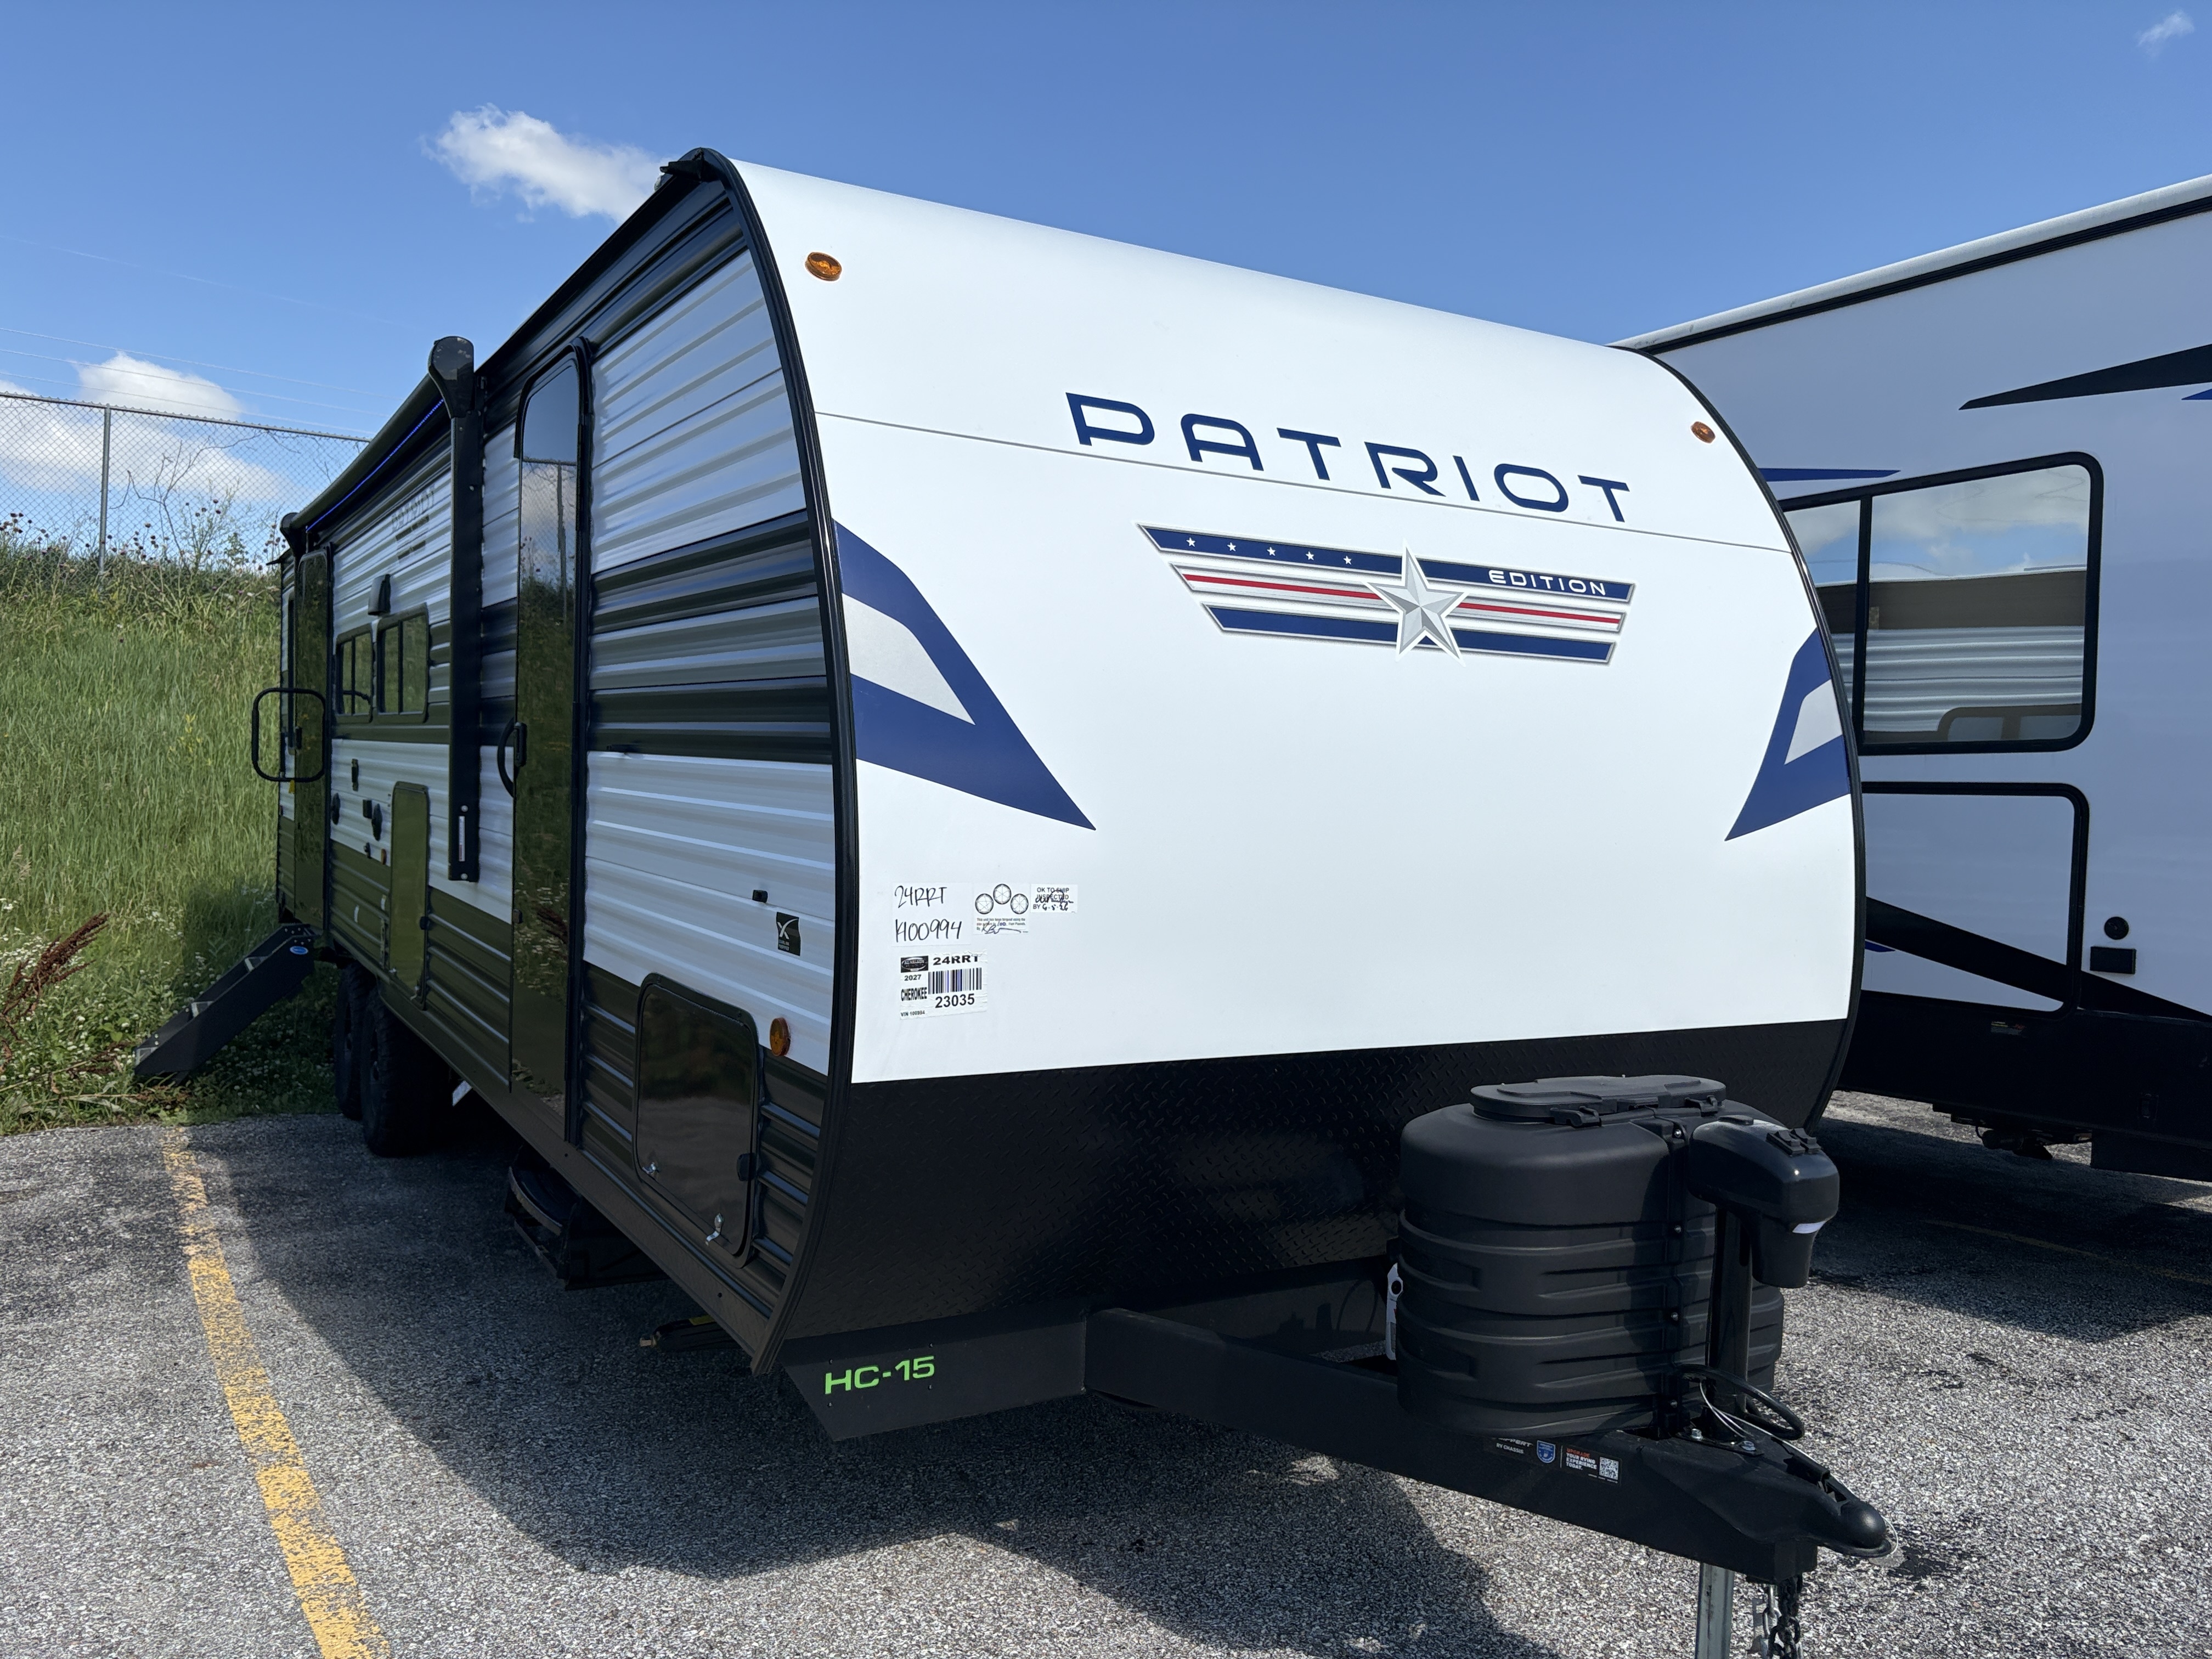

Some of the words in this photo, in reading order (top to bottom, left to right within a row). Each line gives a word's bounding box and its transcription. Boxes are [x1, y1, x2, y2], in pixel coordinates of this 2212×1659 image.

[1065, 392, 1630, 523] PATRIOT
[1488, 569, 1606, 596] EDITION
[894, 885, 947, 909] 24RRT
[933, 955, 979, 966] 24RRT
[901, 987, 927, 1001] CHEROKEE
[935, 993, 975, 1008] 23035
[825, 1355, 935, 1395] HC-15
[1503, 1444, 1525, 1454] CHASSIS
[1566, 1448, 1590, 1458] UPGRADE
[1566, 1457, 1597, 1470] EXPERIENCE
[1566, 1462, 1583, 1470] TODAY.
[1580, 1456, 1596, 1464] RVING
